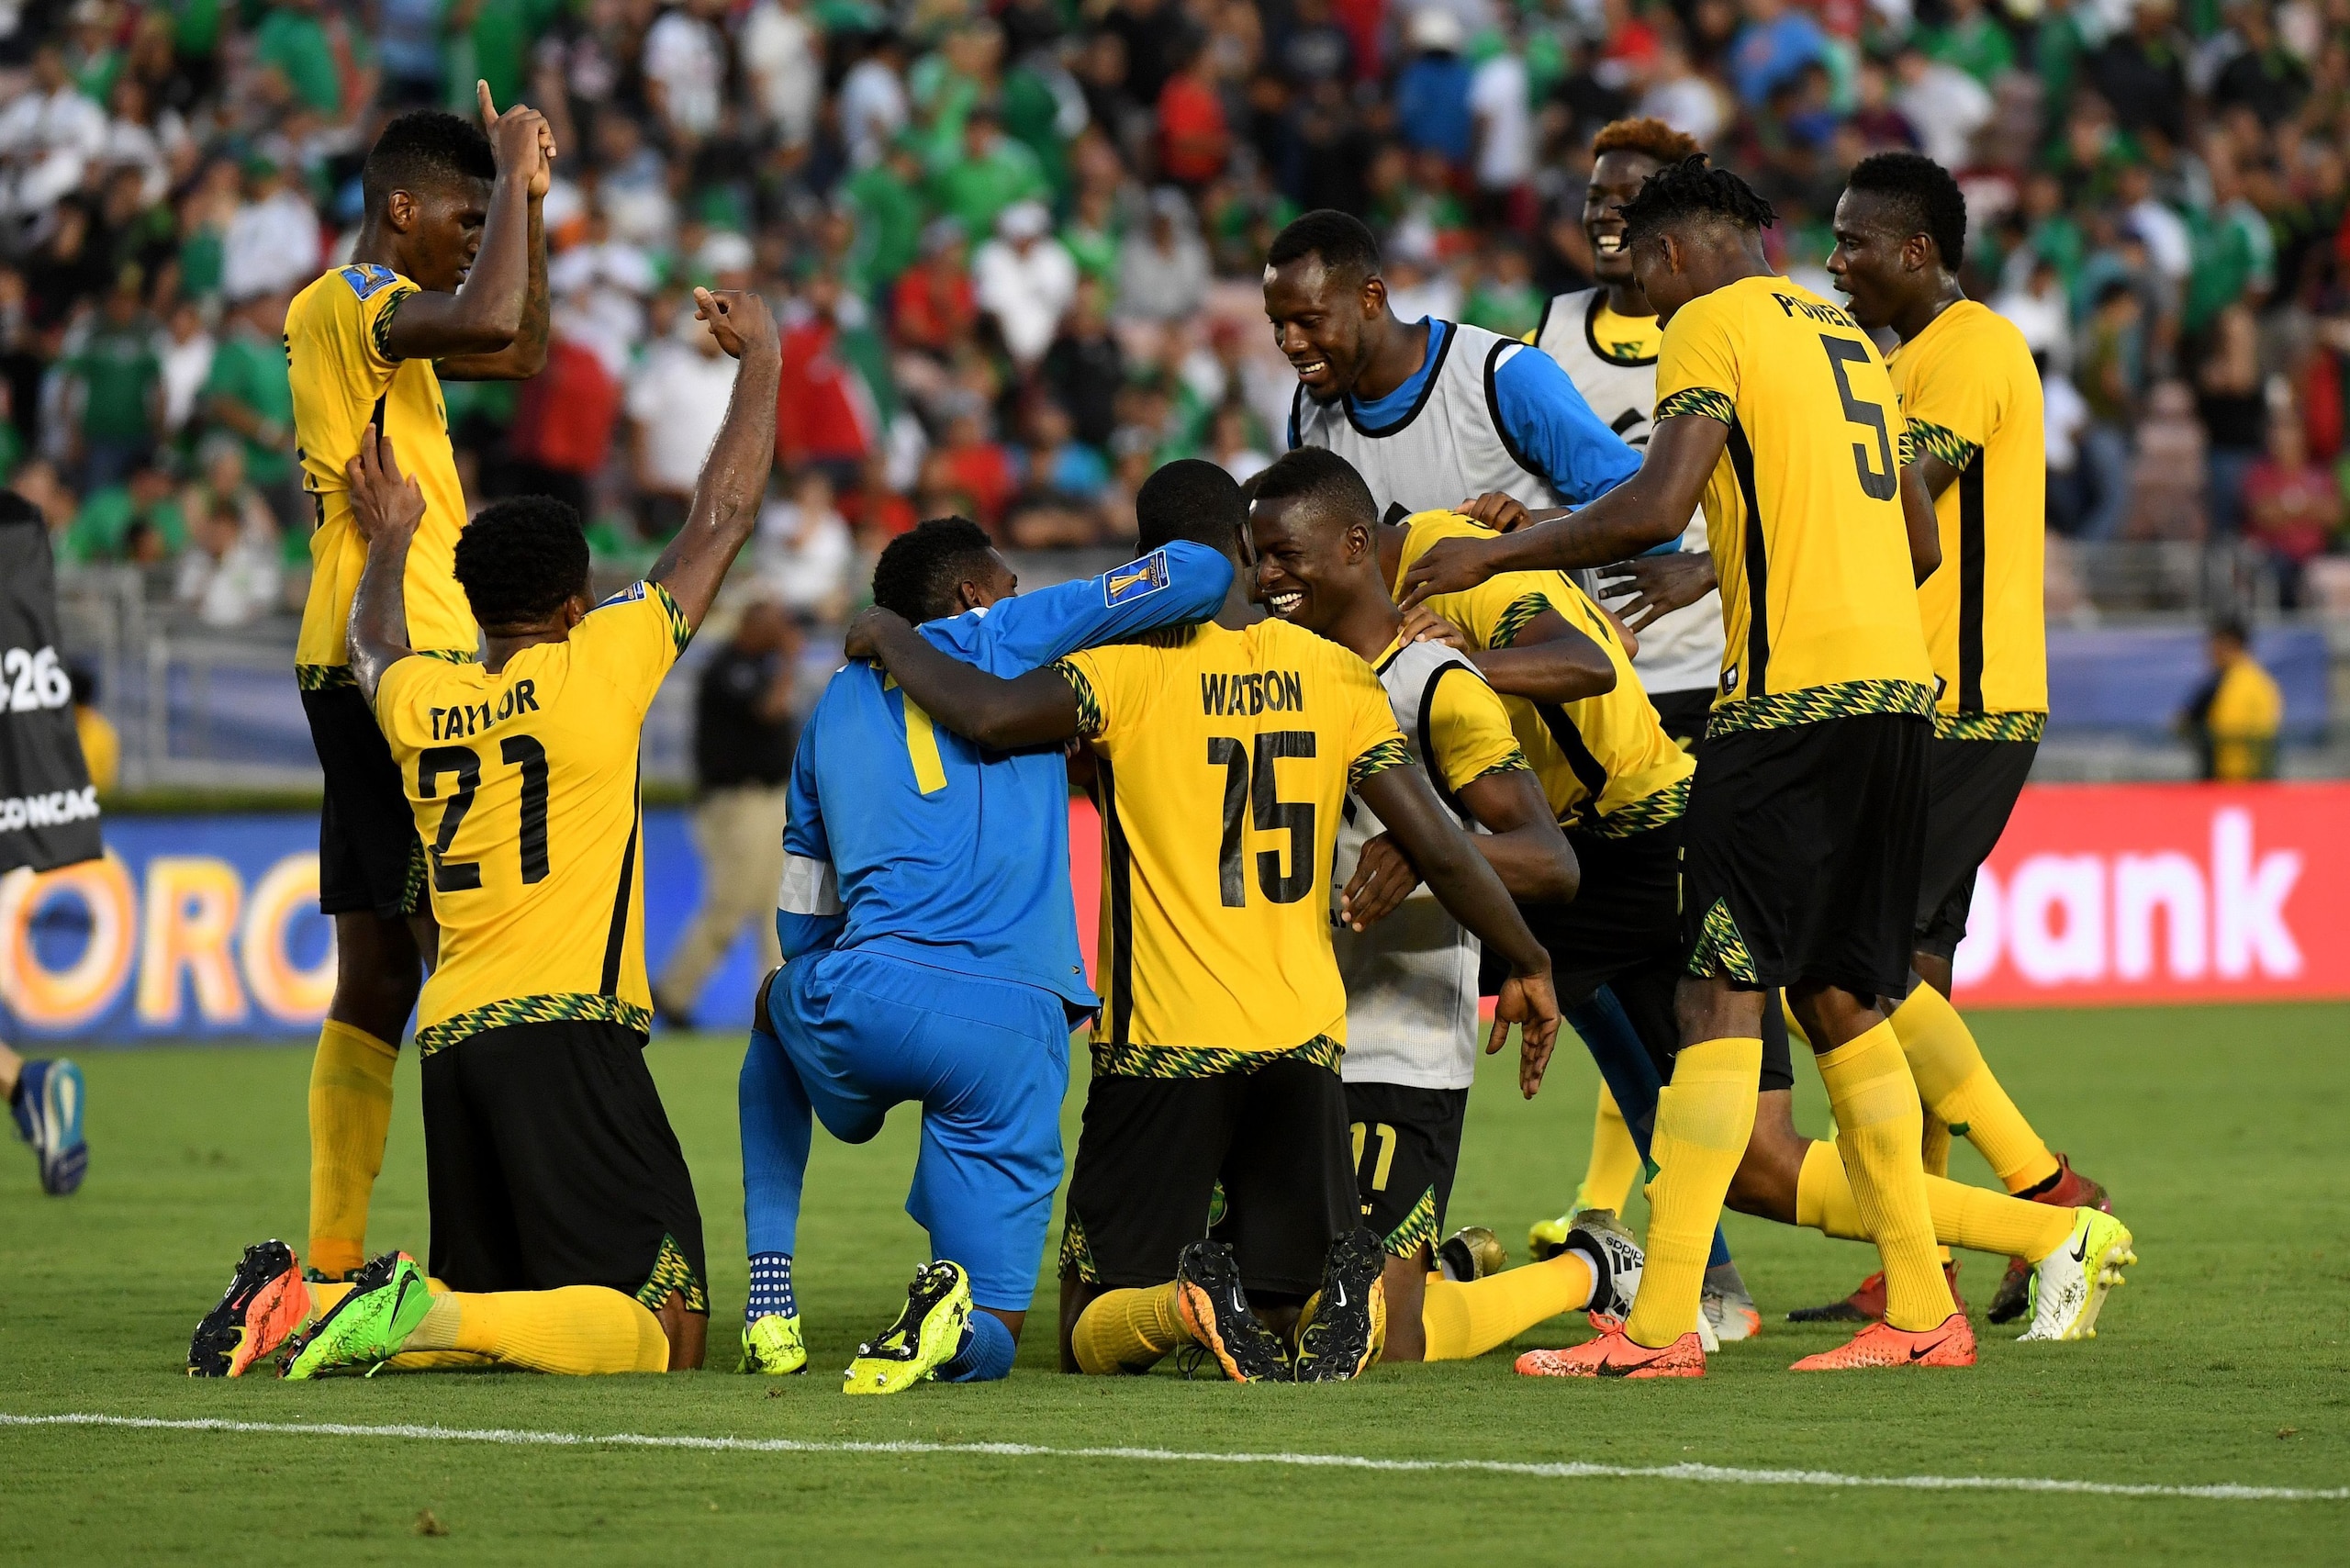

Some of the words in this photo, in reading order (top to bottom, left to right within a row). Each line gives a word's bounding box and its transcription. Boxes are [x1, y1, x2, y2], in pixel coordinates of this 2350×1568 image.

[1771, 292, 1861, 330] POWEL
[1818, 333, 1897, 501] 5
[429, 678, 540, 741] TAYLOR
[1201, 670, 1304, 716] WATSON
[419, 734, 550, 893] 21
[1207, 731, 1316, 908] 15
[1349, 1121, 1397, 1192] 11
[1606, 1236, 1645, 1262] didas
